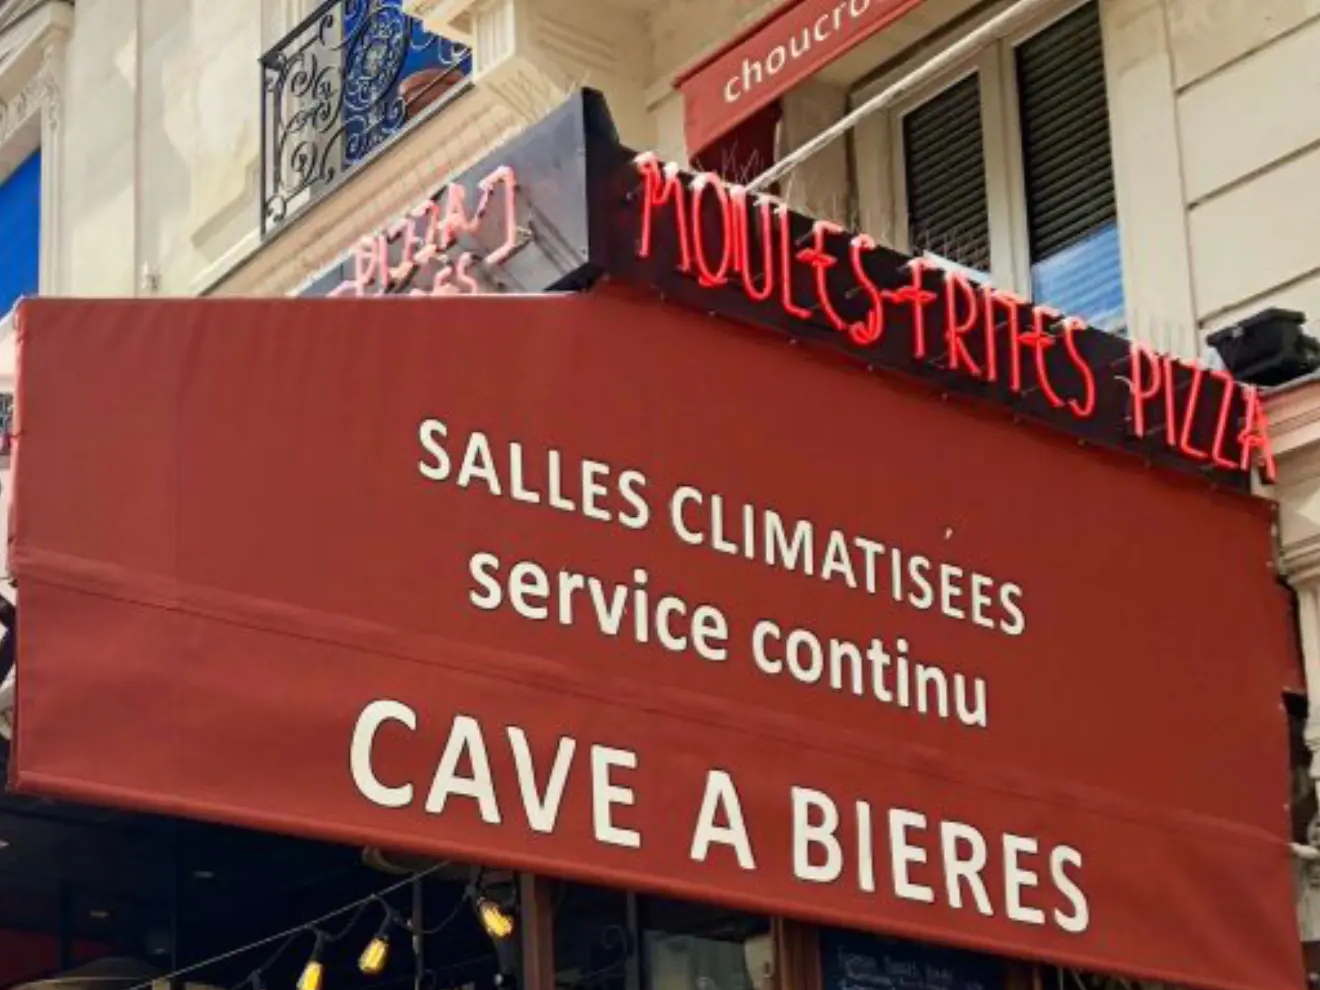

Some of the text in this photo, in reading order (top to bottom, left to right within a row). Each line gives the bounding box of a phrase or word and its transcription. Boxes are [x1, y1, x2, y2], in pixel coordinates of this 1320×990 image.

[417, 417, 650, 530] SALLES
[1129, 339, 1279, 483] PIZZA
[468, 549, 989, 728] service continu
[348, 698, 1091, 933] CAVE A BIERES
